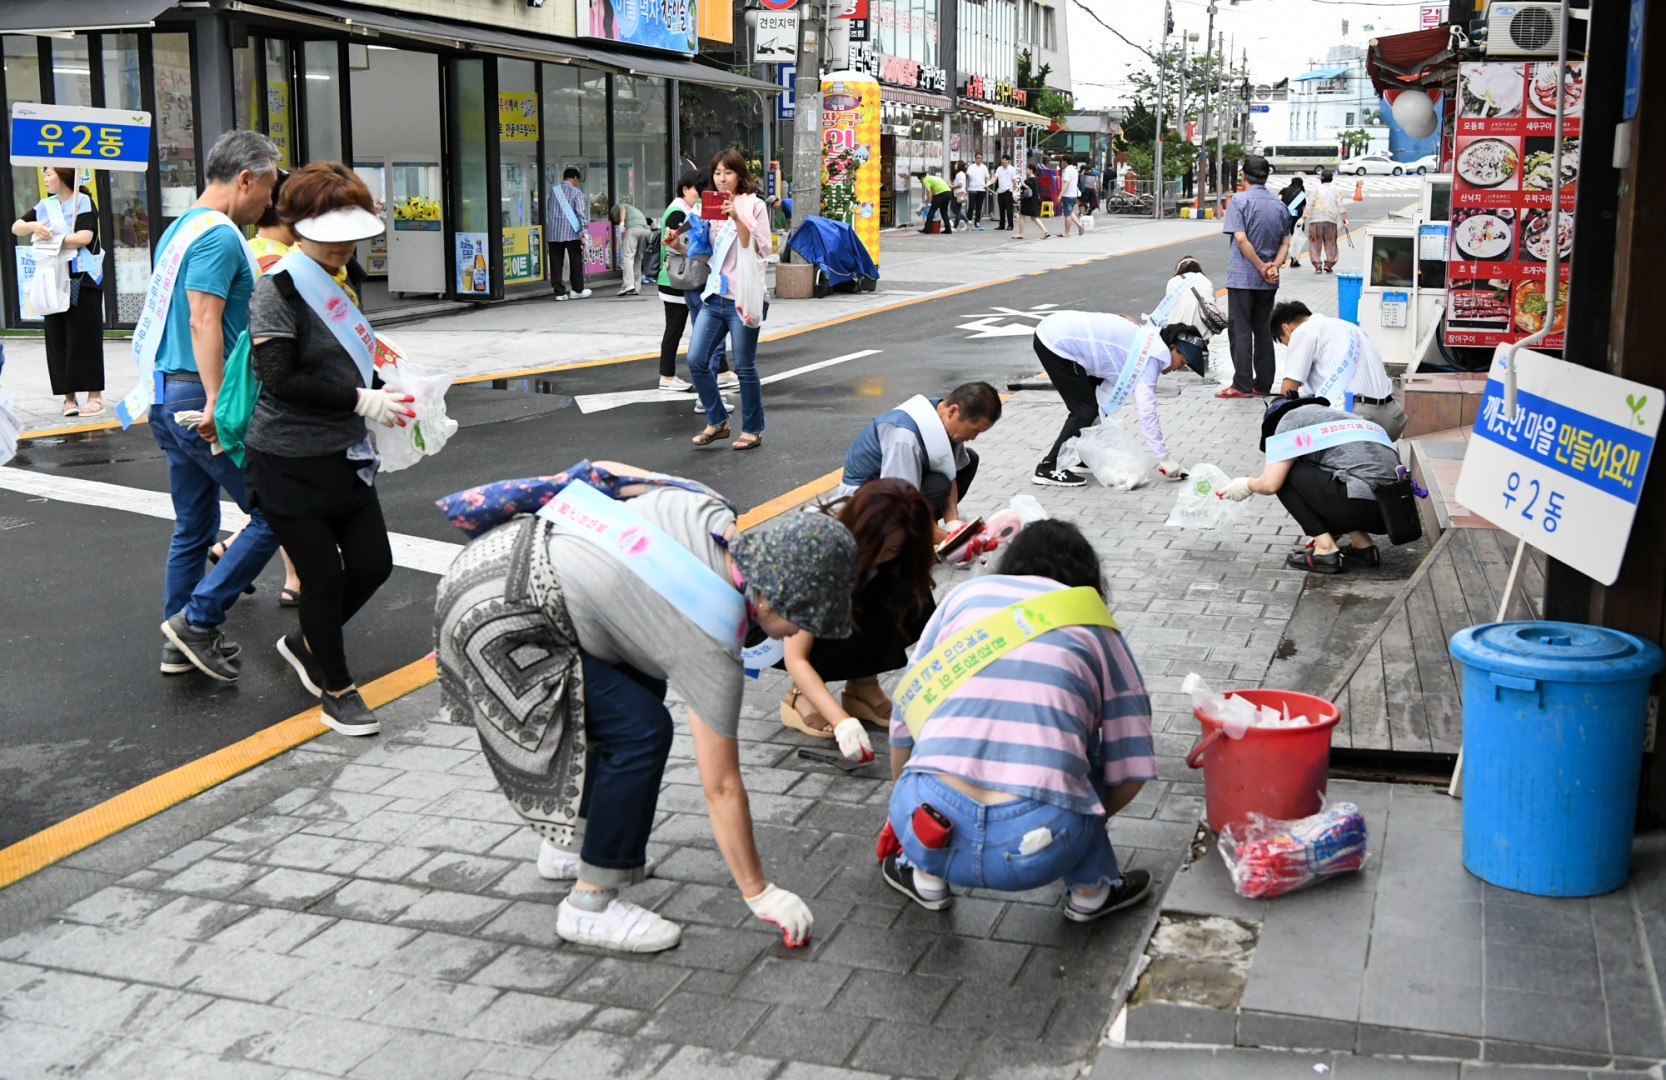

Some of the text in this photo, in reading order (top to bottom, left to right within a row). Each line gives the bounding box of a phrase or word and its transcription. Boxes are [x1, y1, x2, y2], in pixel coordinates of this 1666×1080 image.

[661, 0, 686, 31] 참이슬
[759, 17, 796, 29] 견인지역
[782, 110, 795, 118] 해운
[1463, 121, 1485, 131] 모듬회
[1526, 121, 1552, 131] 새우구이
[37, 123, 124, 157] 우2동
[1460, 193, 1482, 203] 산낙지
[1524, 411, 1557, 455] 마을
[1555, 424, 1641, 489] 만들어요!!
[1502, 472, 1565, 533] 우2동
[938, 635, 1008, 691] 환경정비의
